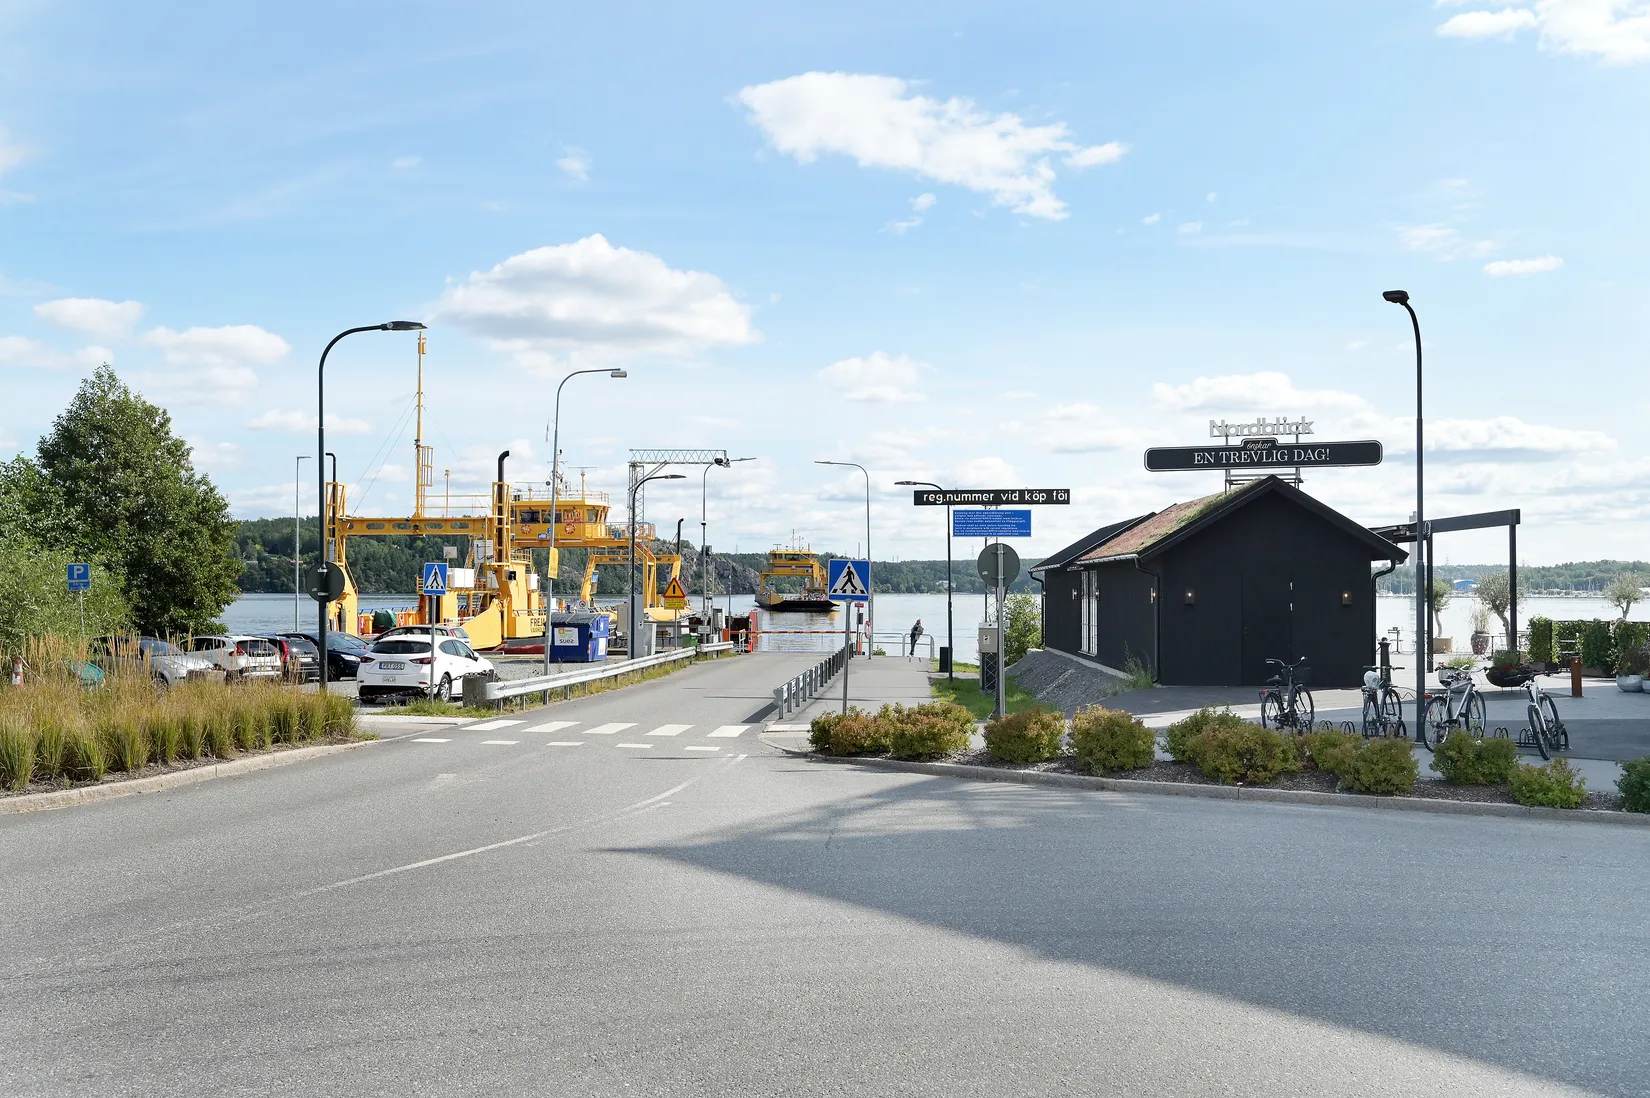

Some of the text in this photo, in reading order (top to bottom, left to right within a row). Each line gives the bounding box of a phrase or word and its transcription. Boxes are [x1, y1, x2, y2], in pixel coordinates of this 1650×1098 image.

[1209, 416, 1315, 437] Nordblick
[1193, 448, 1330, 464] EN TREVLIG DAG!
[923, 492, 995, 503] reg.nummer
[1000, 490, 1019, 501] vid
[1025, 490, 1047, 502] köp
[73, 565, 85, 579] P
